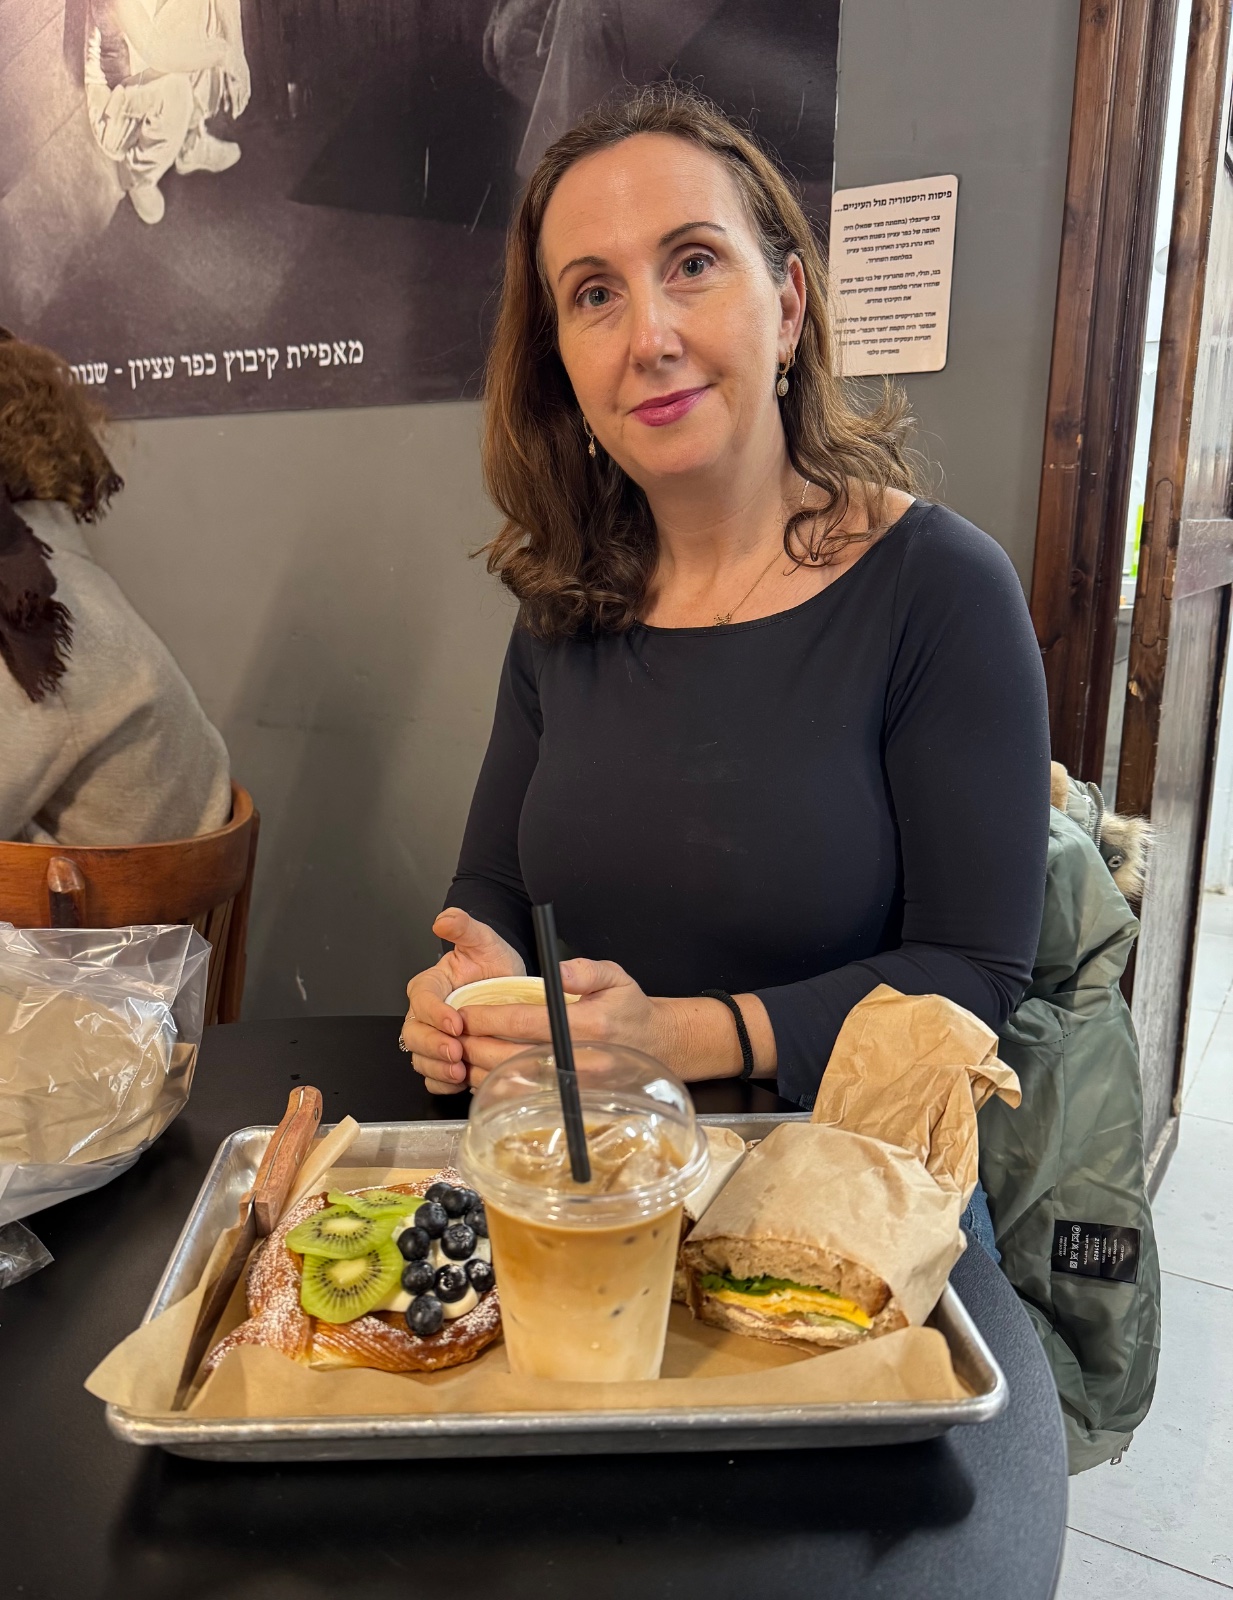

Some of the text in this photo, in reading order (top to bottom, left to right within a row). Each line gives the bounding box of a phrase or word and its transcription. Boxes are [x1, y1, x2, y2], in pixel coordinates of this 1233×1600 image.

[835, 190, 952, 212] פיסות היסטוריה מול העיניים...
[855, 222, 872, 230] שמאל)
[883, 273, 903, 281] מהגרעין
[180, 352, 216, 377] כפר
[223, 347, 279, 383] קיבוץ
[287, 339, 364, 369] מאפיית
[128, 355, 175, 389] עציון
